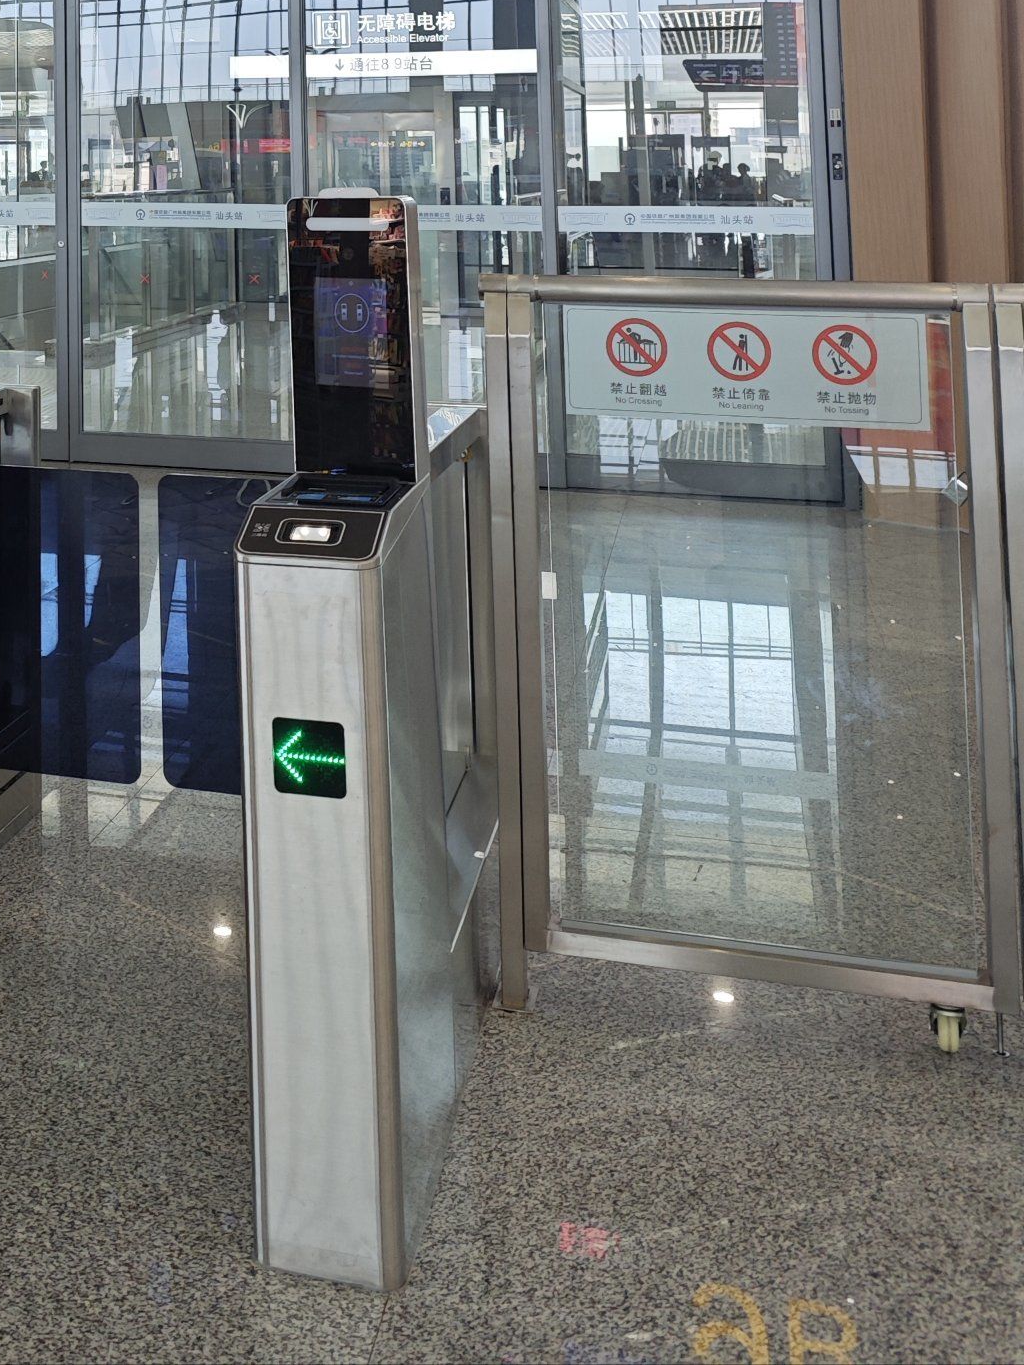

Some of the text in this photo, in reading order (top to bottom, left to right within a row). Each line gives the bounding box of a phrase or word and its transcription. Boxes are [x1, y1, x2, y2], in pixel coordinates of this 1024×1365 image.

[357, 11, 456, 32] 无障碍电梯
[356, 33, 449, 44] Accessible Elevator
[215, 211, 243, 220] 汕头站
[455, 213, 486, 222] 汕头站
[720, 214, 753, 225] 汕头站
[611, 383, 667, 396] 禁止翻越
[712, 387, 771, 401] 禁止倚靠
[628, 397, 663, 406] Crossing
[817, 392, 876, 405] 禁止抛物
[719, 401, 764, 411] No Leaning
[839, 406, 869, 416] Tossing
